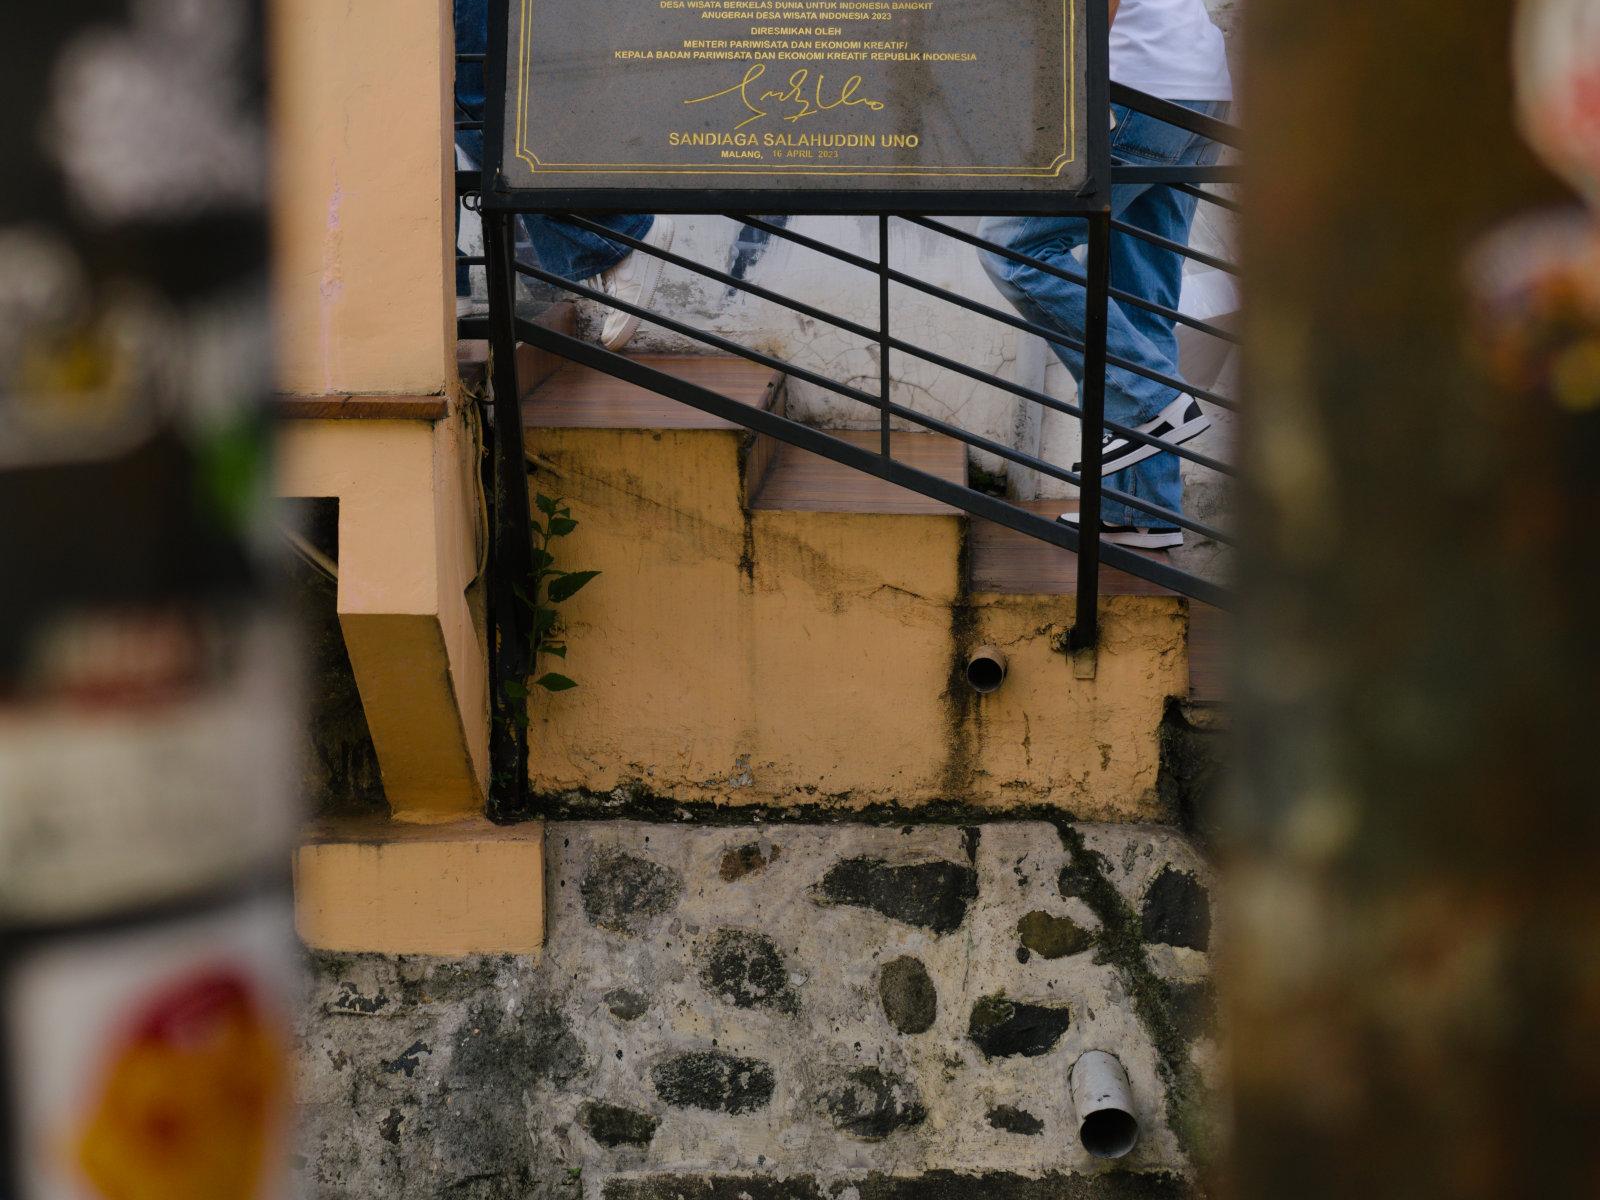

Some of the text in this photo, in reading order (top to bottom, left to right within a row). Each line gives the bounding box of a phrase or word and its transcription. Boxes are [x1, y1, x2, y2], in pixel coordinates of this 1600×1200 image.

[660, 1, 933, 10] DESA WISATA BERKELAS DUNIA UNTUK INDONESIA BANGKIT
[701, 11, 892, 20] ANUGERAH DESA WISATA INDONESIA 2023
[750, 27, 842, 36] DIRESMIKAN OLEH
[683, 40, 908, 50] MENTERI PARIWISATA DAN EKONOMI KREATIF/
[614, 51, 977, 61] KEPALA BADAN PARIWISATA DAN EKONOMI KREATIF REPUBLIK INDONESIA
[668, 132, 920, 148] SANDIAGA SALAHUDDIN UNO
[720, 150, 839, 159] MALANG, 16 APRIL 2023
